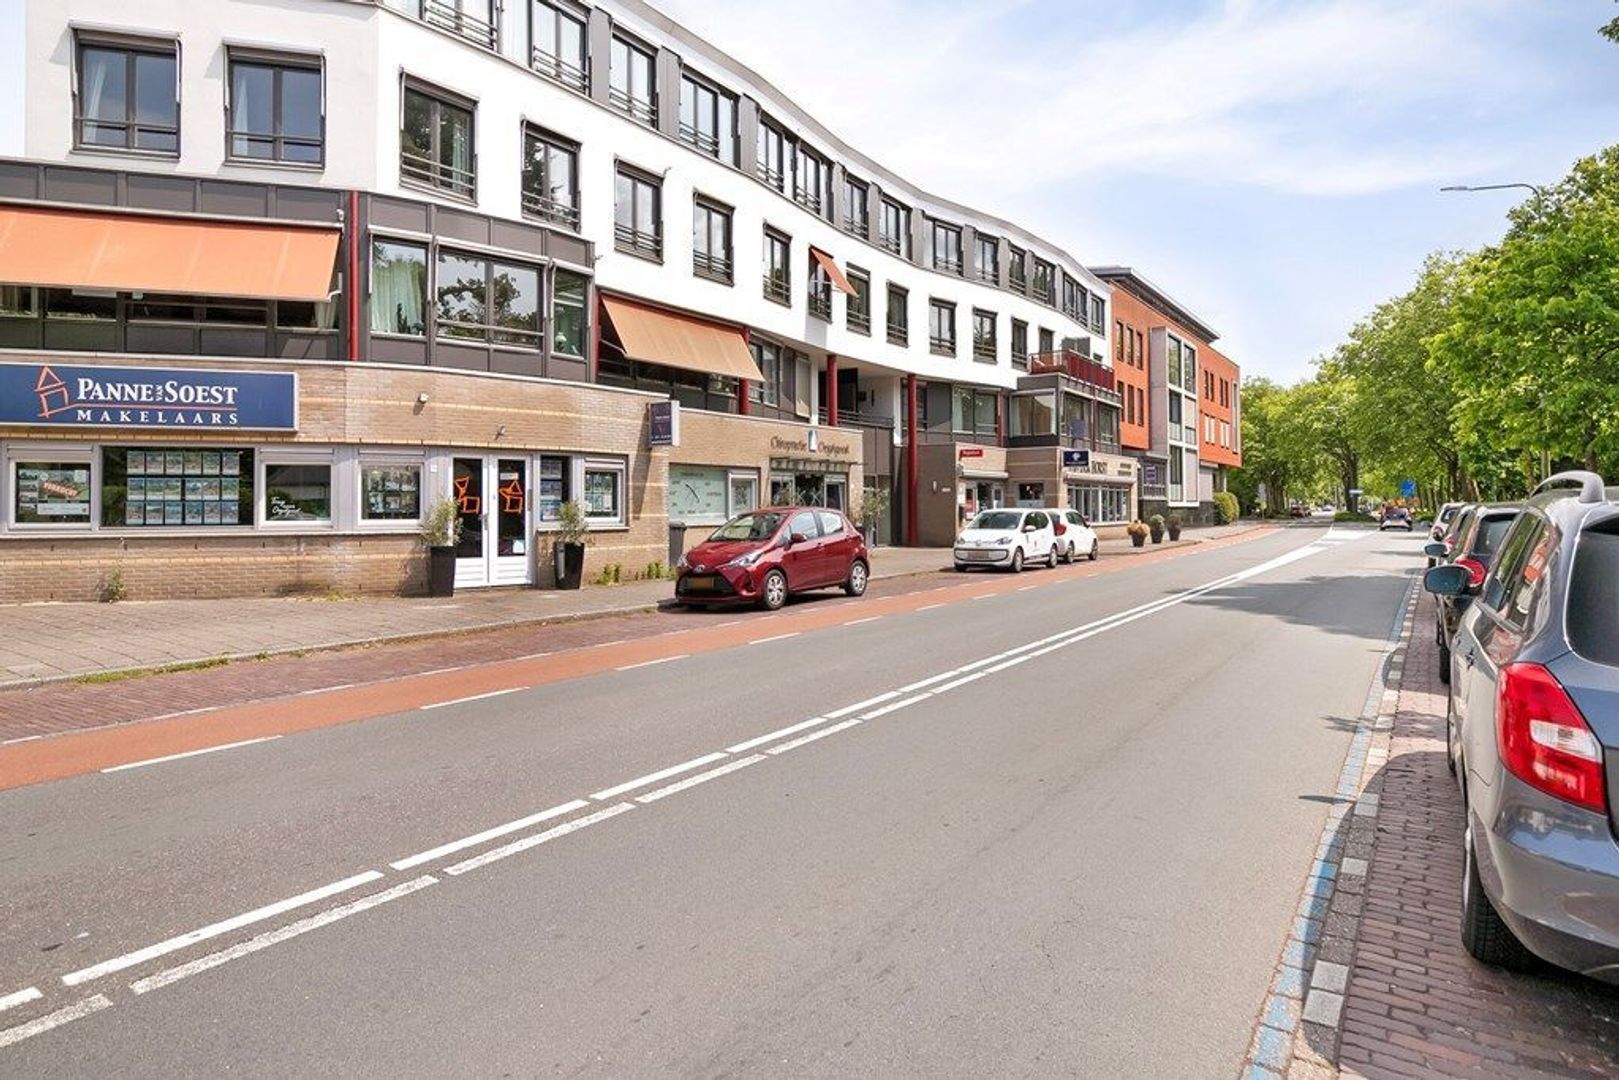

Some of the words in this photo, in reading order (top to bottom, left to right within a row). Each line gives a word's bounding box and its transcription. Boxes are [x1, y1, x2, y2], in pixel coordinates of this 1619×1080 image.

[77, 378, 154, 402] PANNE
[164, 381, 238, 405] SOEST
[77, 410, 238, 424] MAKELAARS
